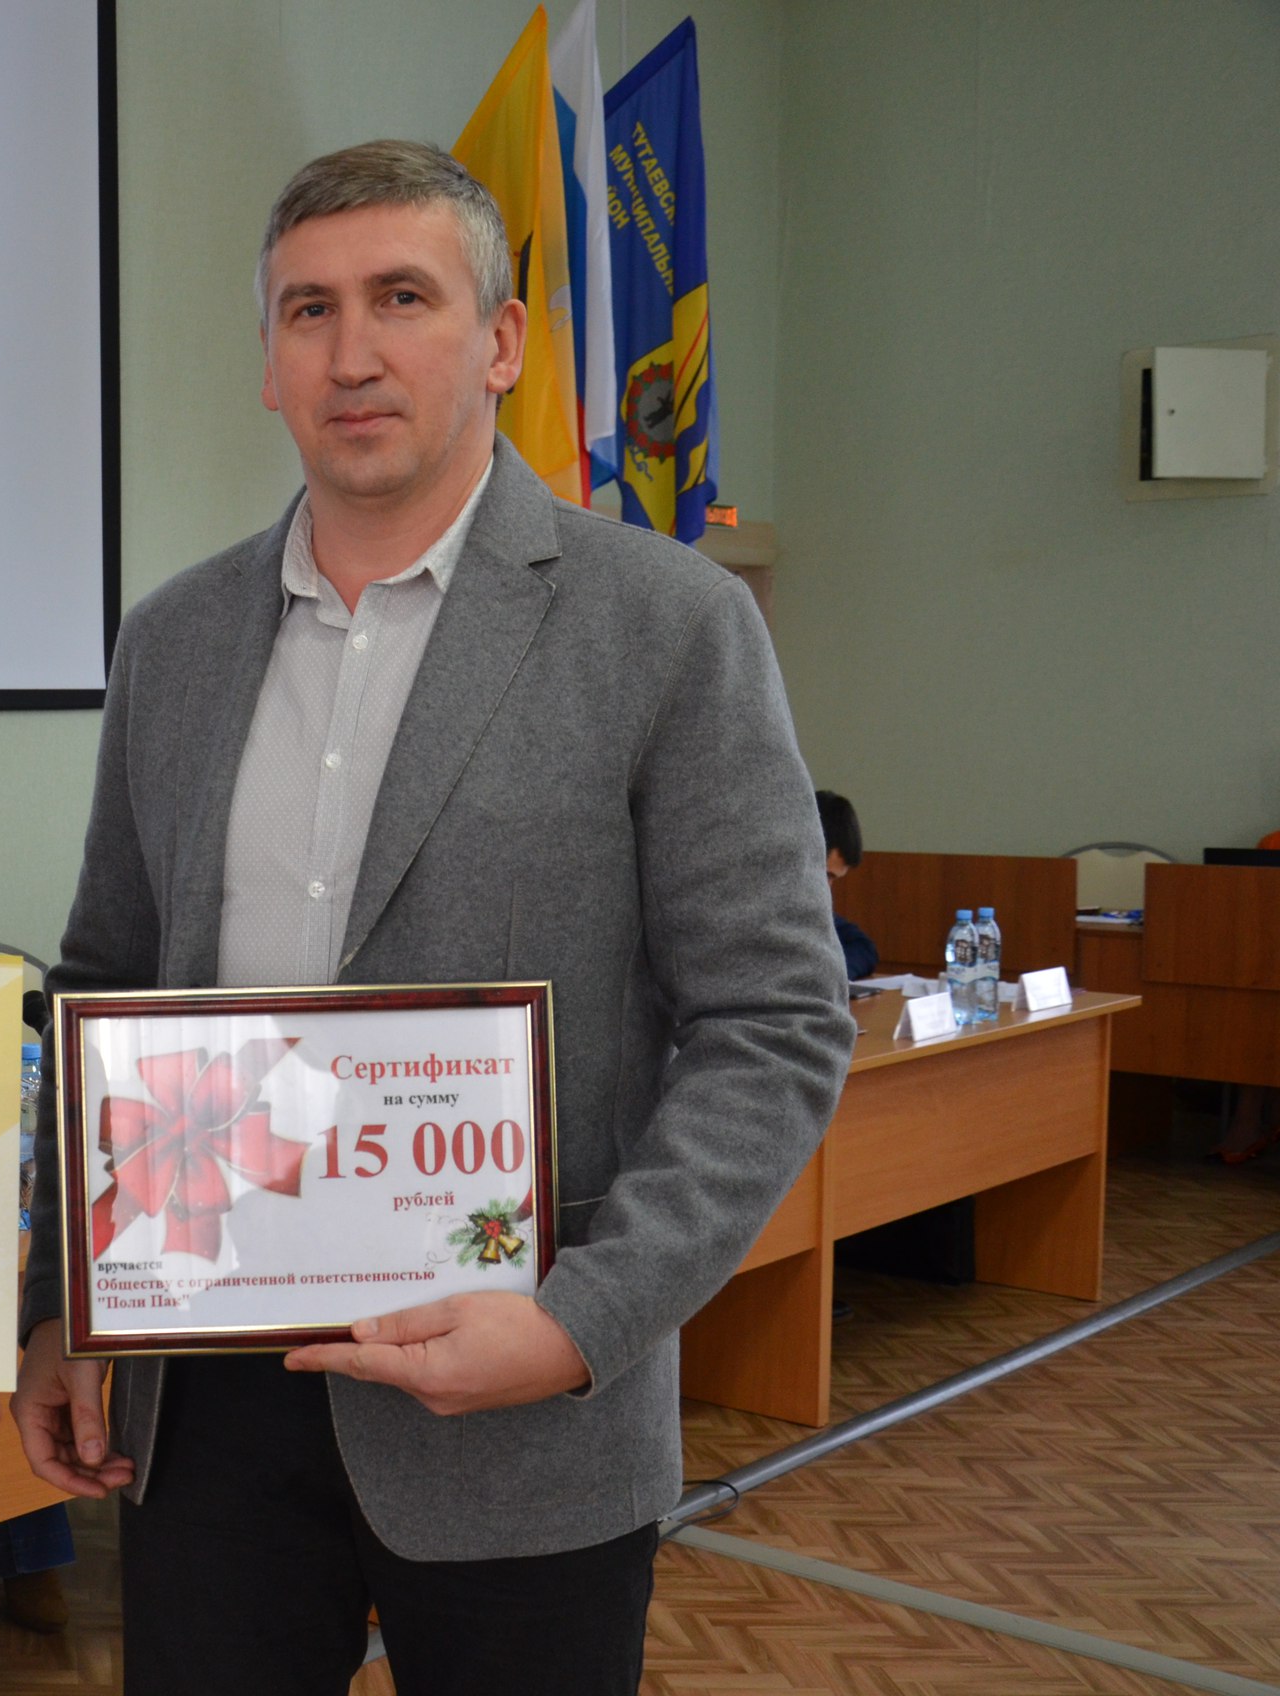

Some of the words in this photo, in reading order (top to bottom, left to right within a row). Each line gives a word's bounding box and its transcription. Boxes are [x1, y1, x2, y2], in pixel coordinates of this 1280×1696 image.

[330, 1053, 515, 1085] Сертификат
[383, 1095, 403, 1105] на
[409, 1093, 459, 1108] сумму
[317, 1124, 389, 1179] 15
[412, 1119, 525, 1176] 000
[393, 1191, 455, 1211] рублей
[98, 1261, 163, 1274] вручается
[97, 1277, 173, 1293] Обществу
[177, 1280, 185, 1289] с
[189, 1274, 296, 1291] ограниченной
[300, 1270, 435, 1285] ответственностью
[97, 1296, 146, 1310] "Поли
[151, 1294, 190, 1309] Пак"
